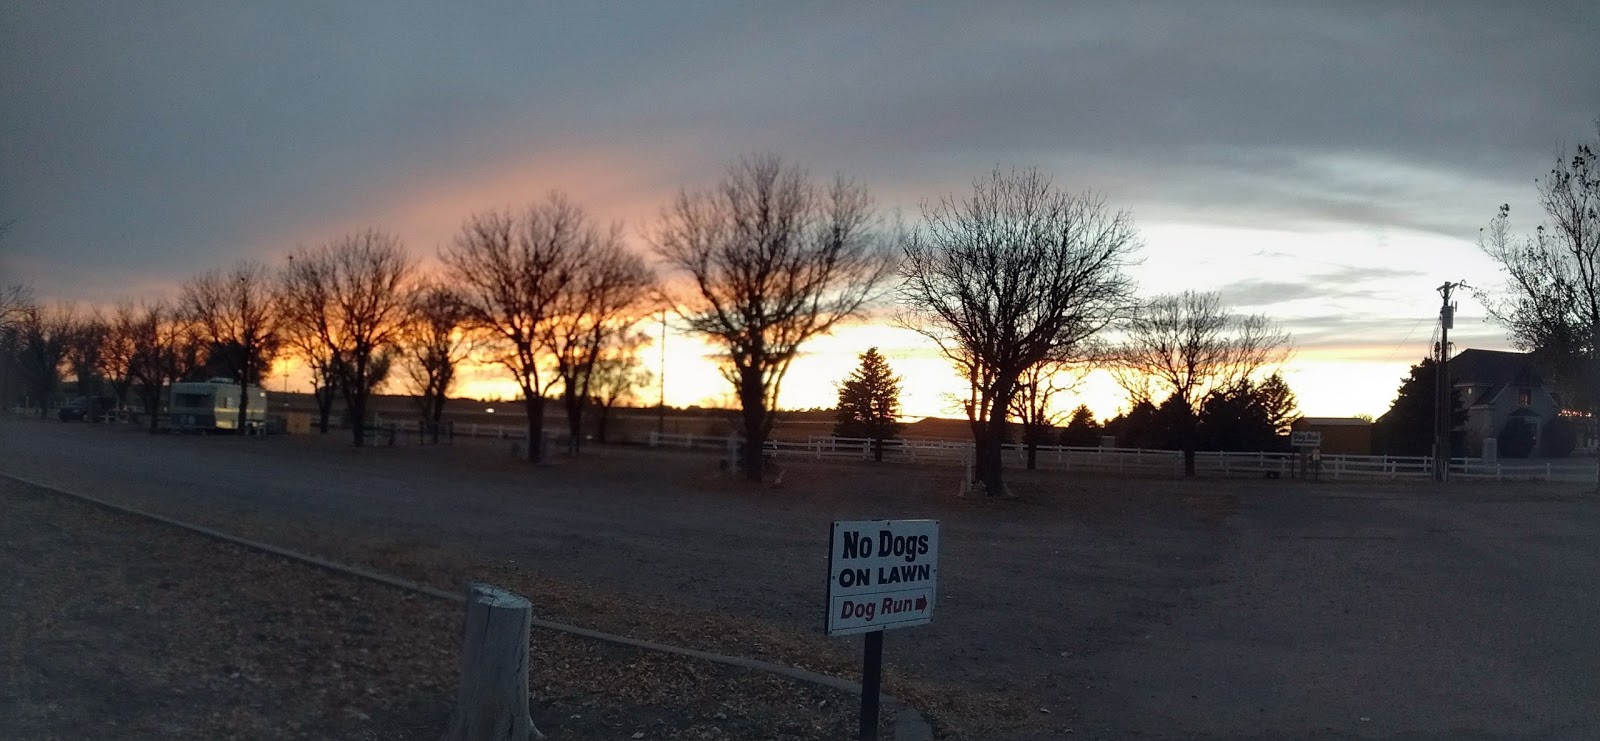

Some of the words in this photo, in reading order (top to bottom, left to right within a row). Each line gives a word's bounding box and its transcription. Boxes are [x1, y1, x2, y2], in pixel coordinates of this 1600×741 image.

[1293, 433, 1306, 441] Dog
[842, 531, 873, 559] No
[878, 530, 929, 562] Dogs
[839, 568, 870, 588] ON
[878, 564, 930, 585] LAWN
[841, 600, 876, 621] Dog
[881, 597, 913, 615] Run
